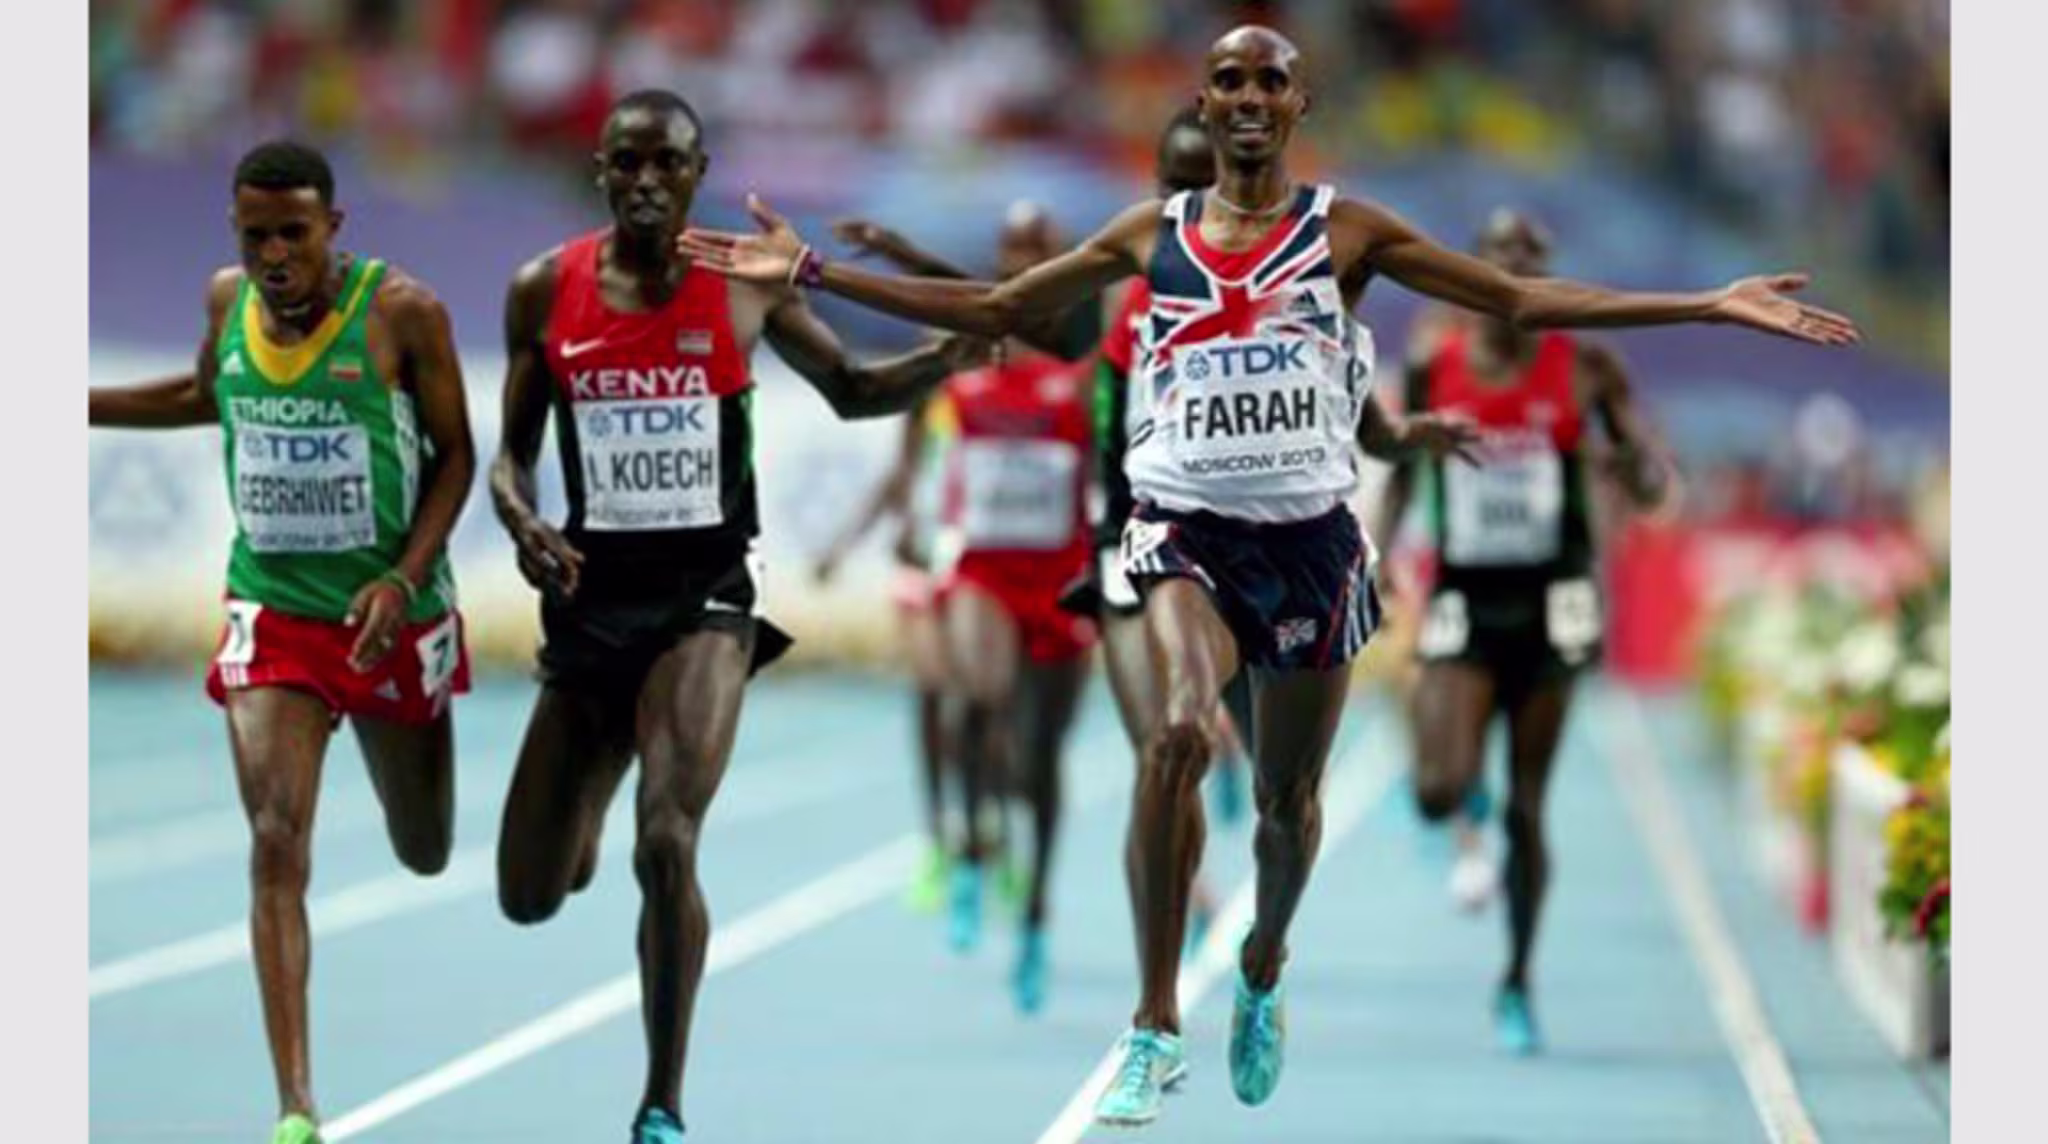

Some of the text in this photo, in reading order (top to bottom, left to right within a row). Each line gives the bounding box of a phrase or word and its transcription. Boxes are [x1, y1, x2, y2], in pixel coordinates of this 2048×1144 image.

[1208, 341, 1306, 377] TDK
[569, 365, 709, 398] KENYA
[231, 398, 348, 422] ETHIOPIA
[612, 404, 704, 434] TDK
[1184, 387, 1316, 440] FARAH
[264, 432, 352, 463] TDK
[1182, 452, 1276, 474] MOSCOW
[611, 449, 713, 491] KOECH
